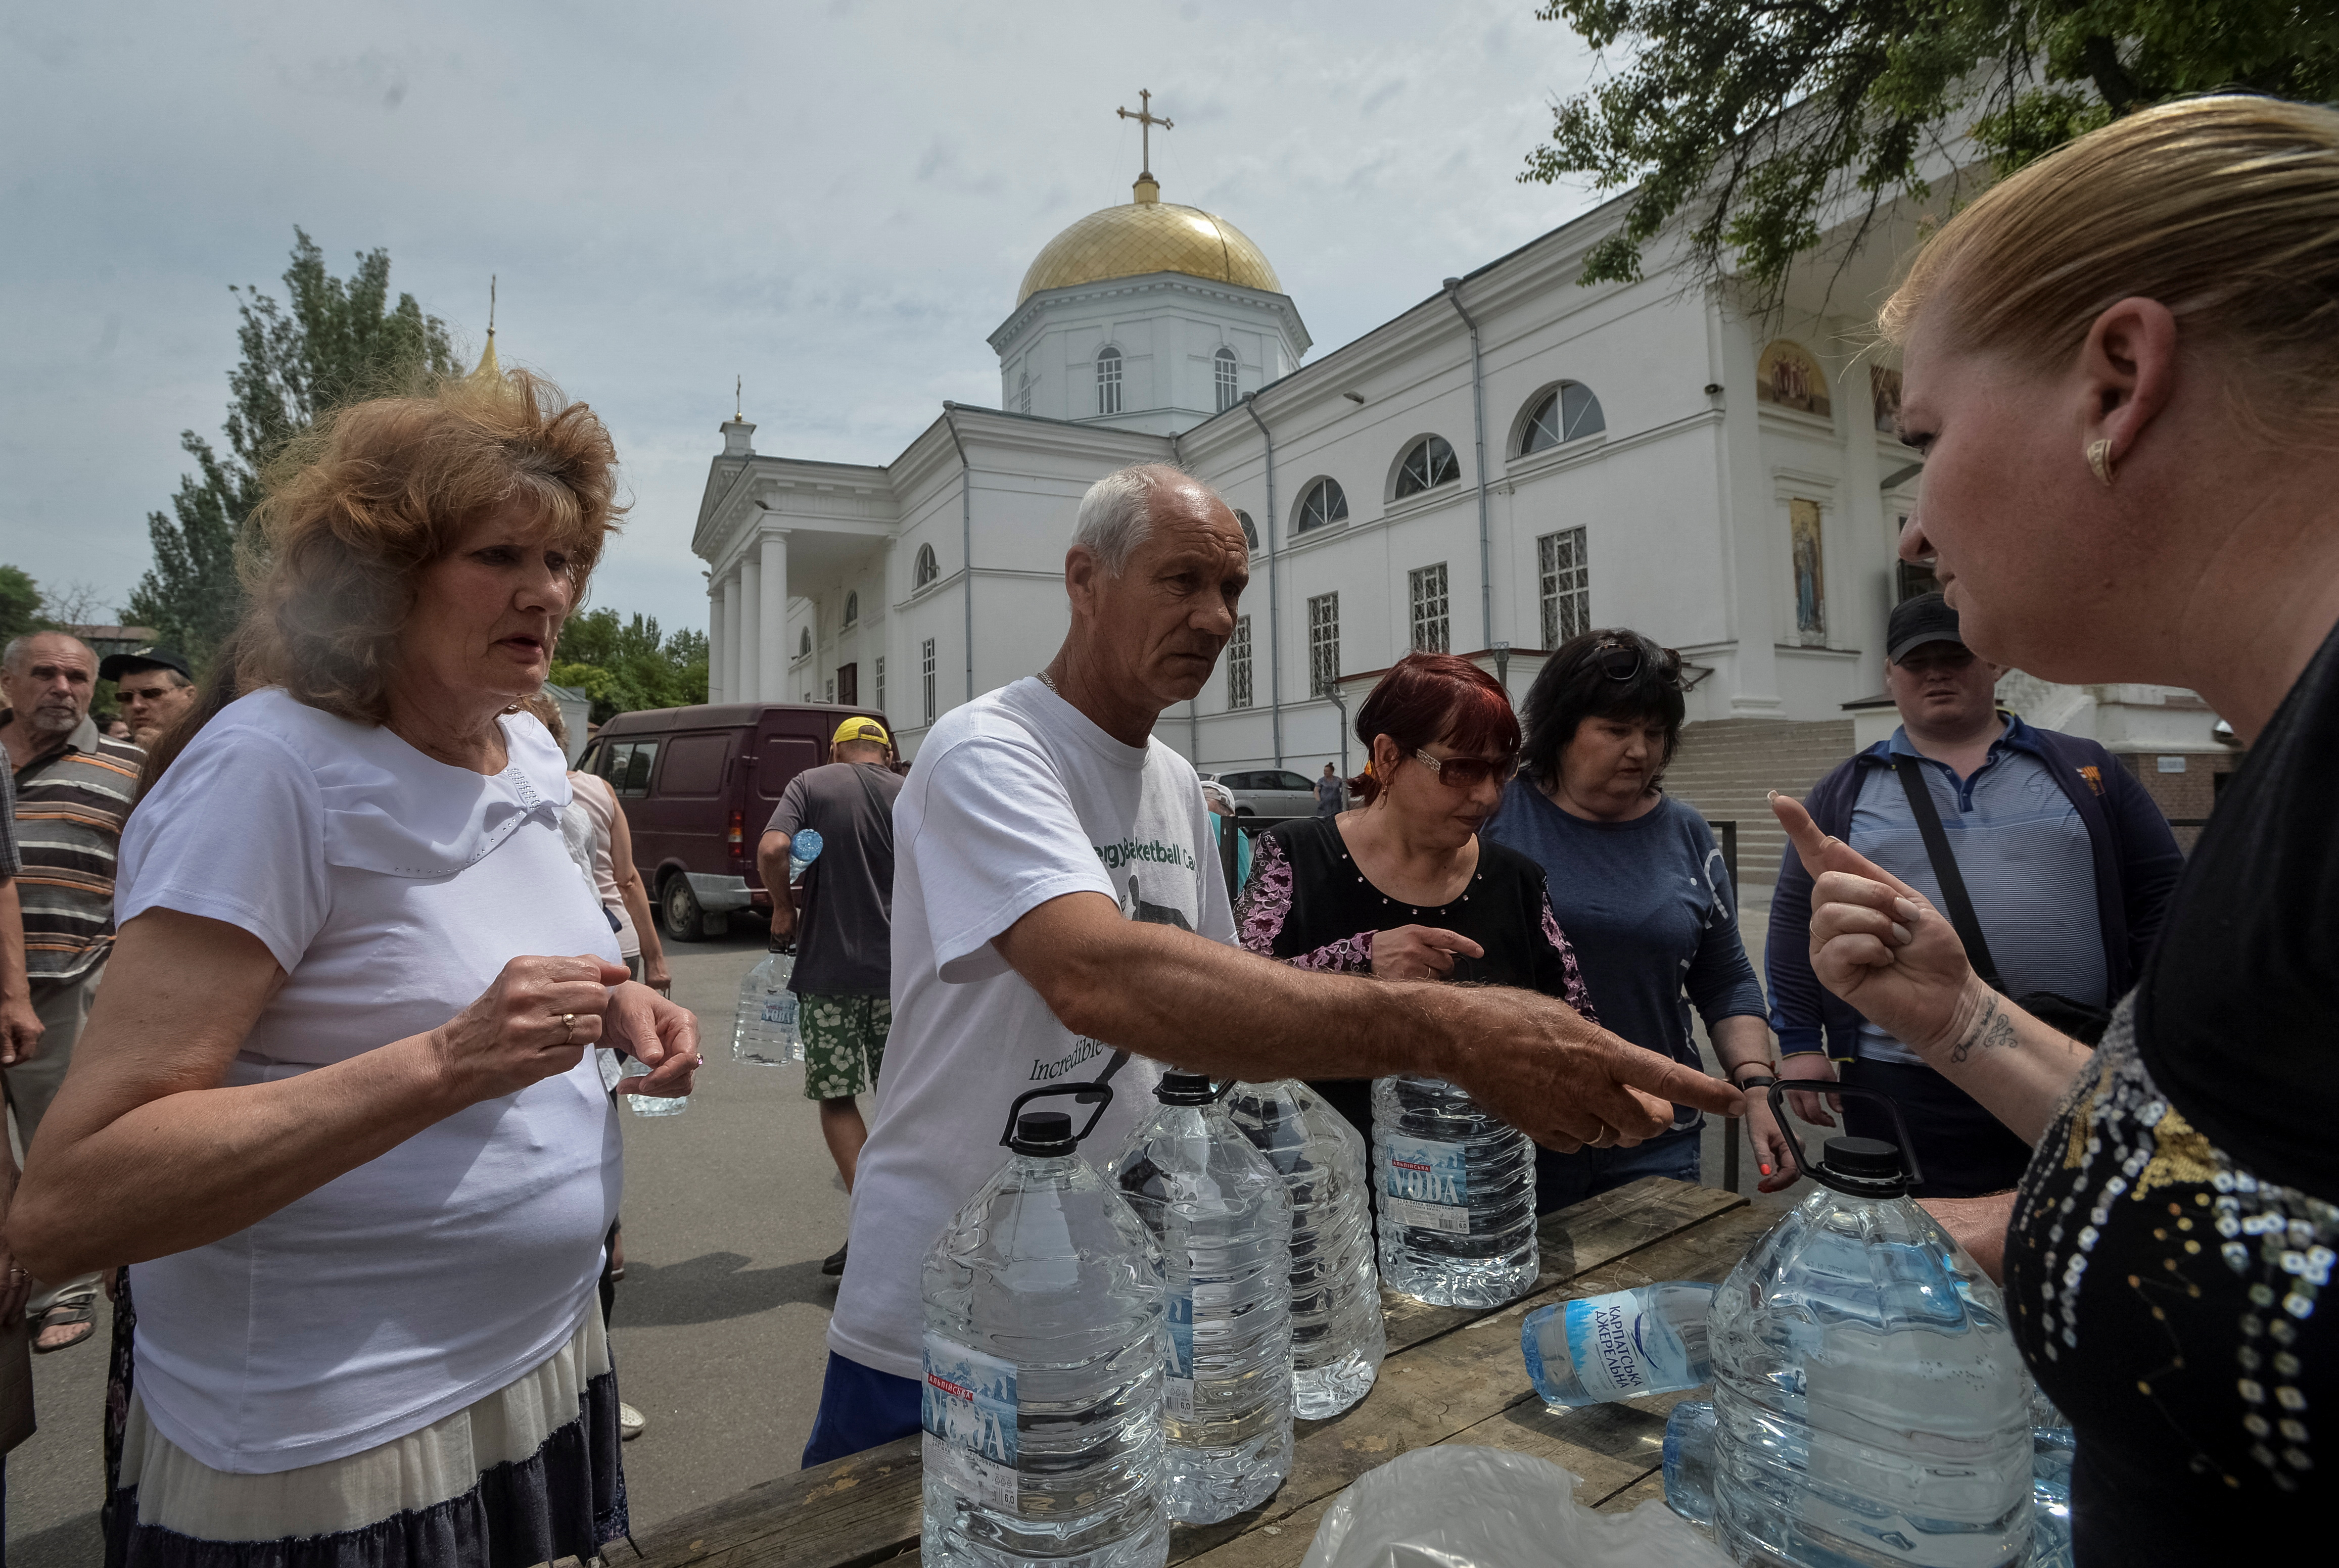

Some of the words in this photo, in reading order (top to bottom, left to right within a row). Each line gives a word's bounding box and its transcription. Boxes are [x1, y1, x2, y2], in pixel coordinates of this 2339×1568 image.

[1183, 848, 1197, 871] Ca
[1028, 1037, 1103, 1080] Incredible
[1393, 1161, 1429, 1171] АЛЬПІЙСЬКА
[1393, 1168, 1459, 1204] VODA
[1595, 1311, 1630, 1389] ДЖЕРЕЛЬНА
[1609, 1306, 1644, 1387] КАРПАТСЬКА
[929, 1375, 970, 1399] АЛЬПІЙСЬКА
[1180, 1402, 1190, 1410] 6,0
[1004, 1494, 1014, 1504] 6,0
